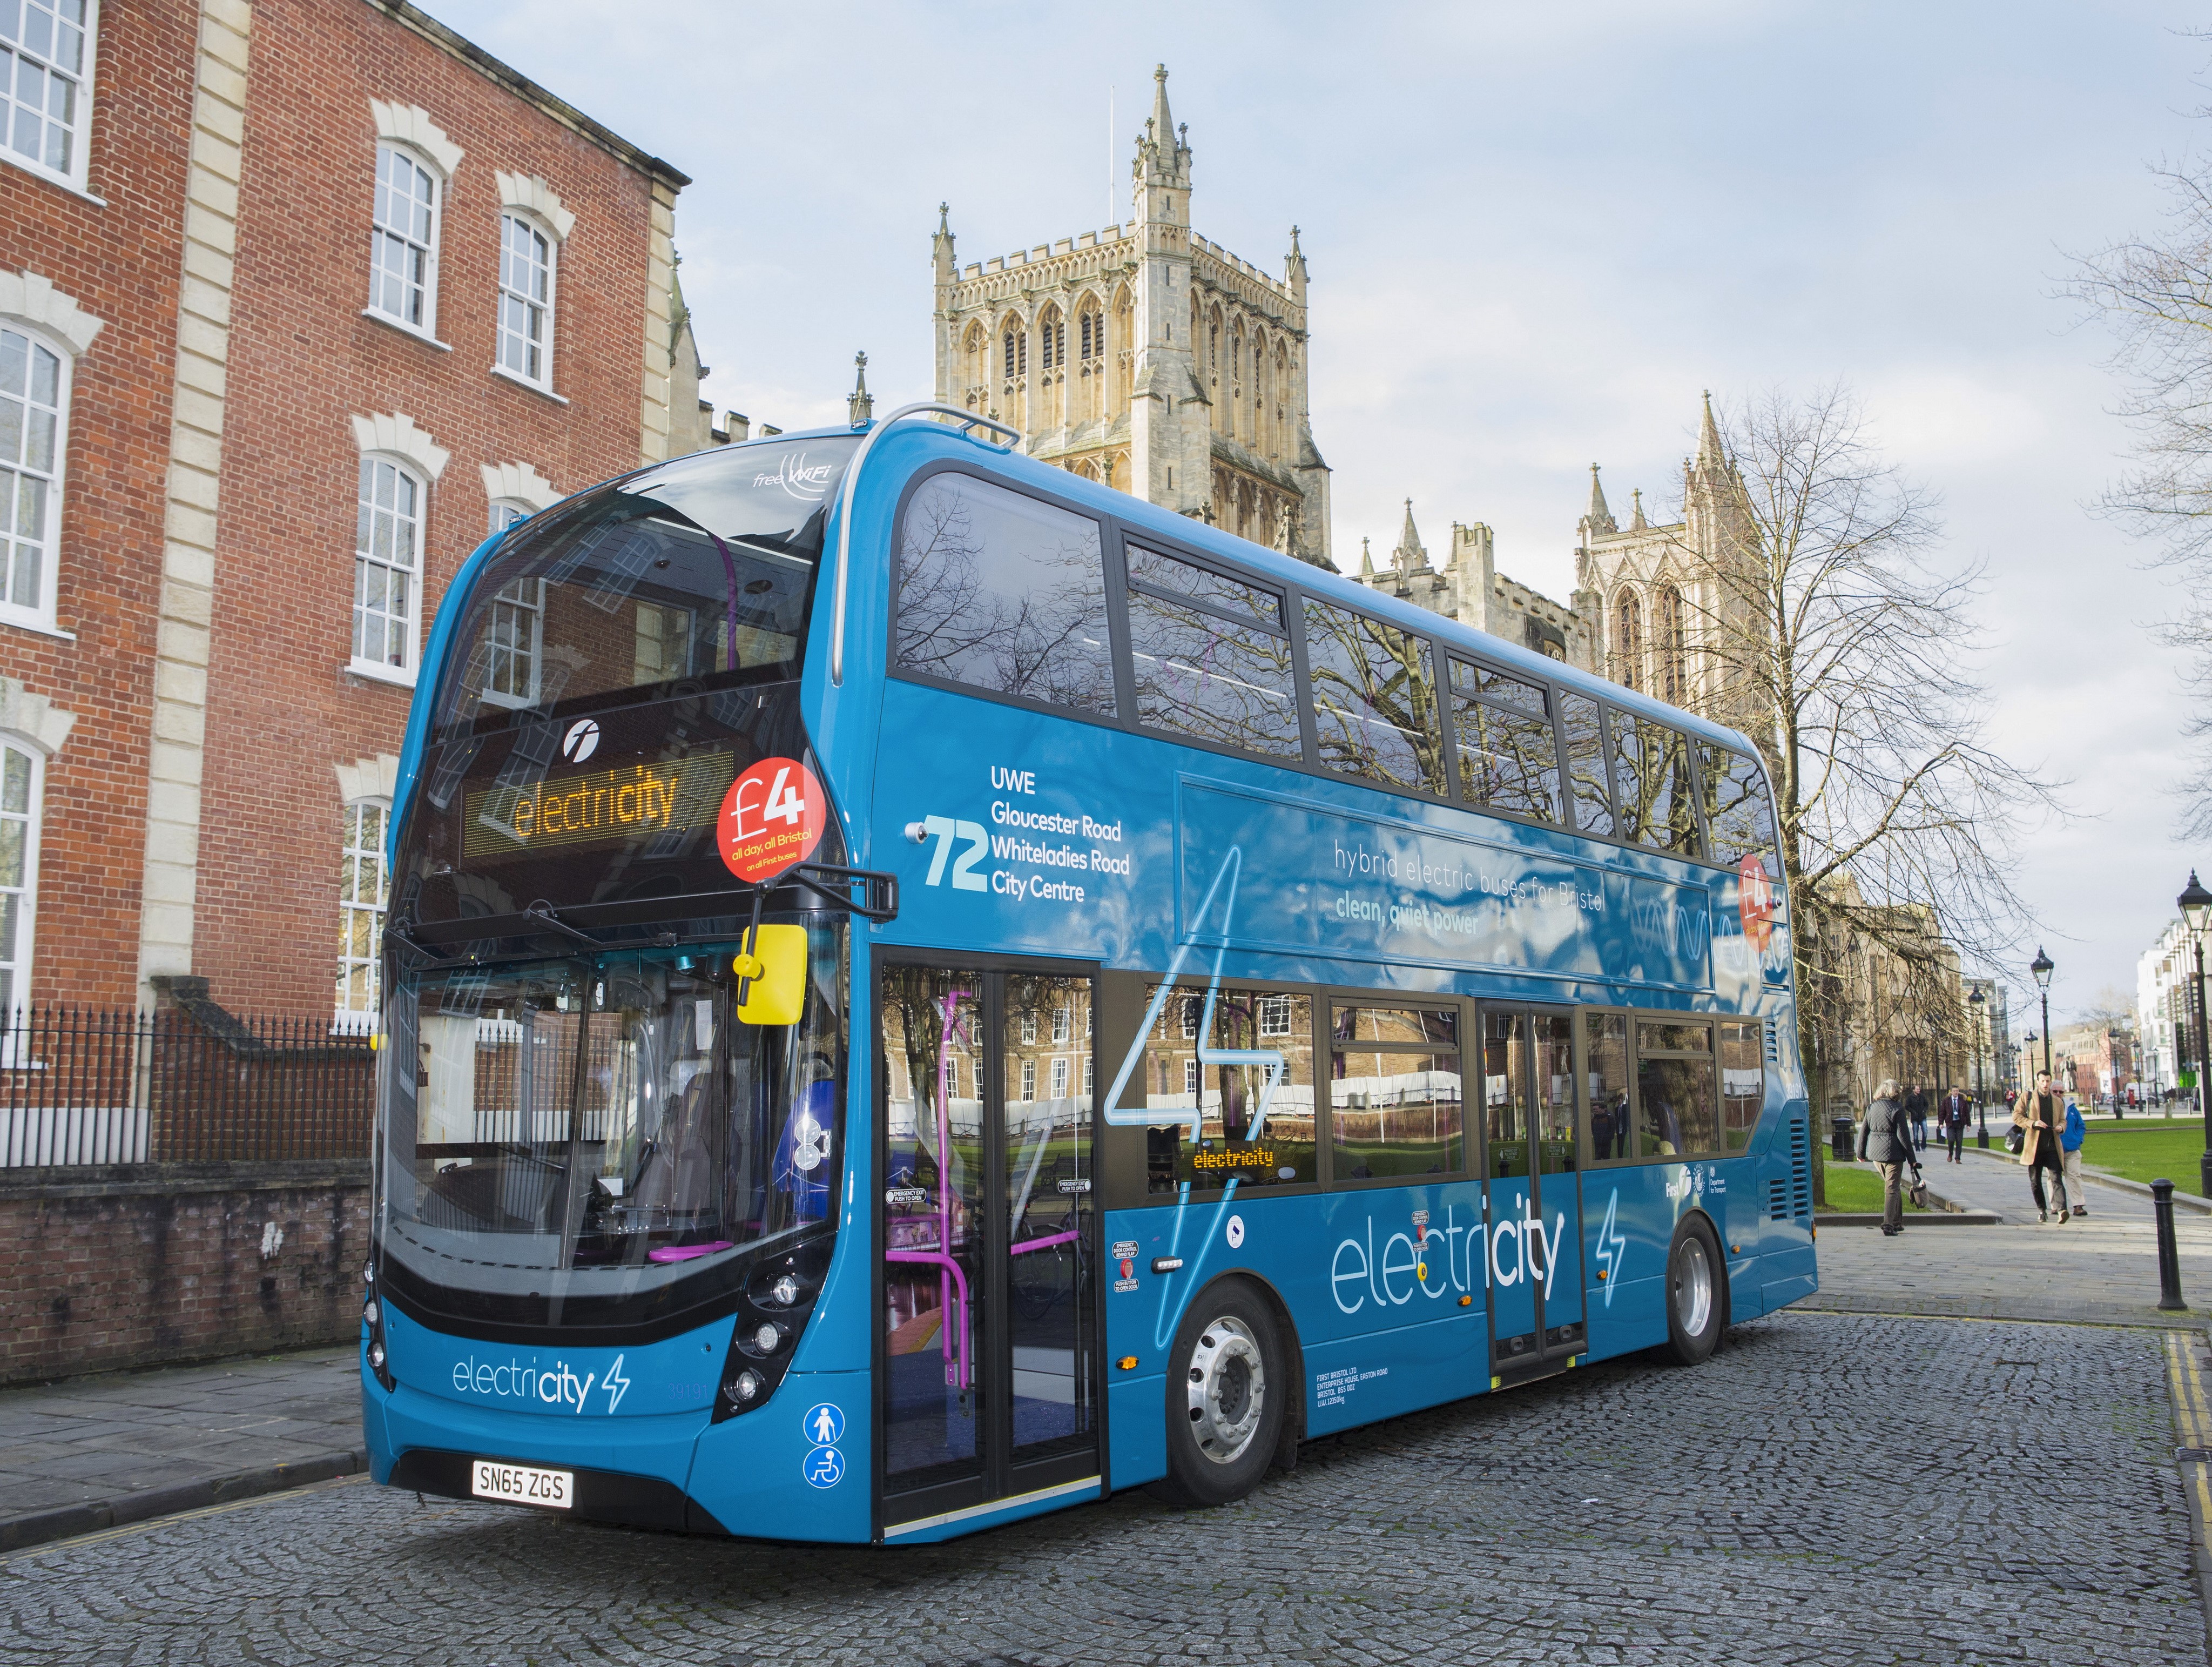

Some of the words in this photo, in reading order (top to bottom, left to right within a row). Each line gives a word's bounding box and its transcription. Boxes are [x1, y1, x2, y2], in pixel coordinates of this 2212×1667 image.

[753, 473, 784, 487] free
[991, 765, 1035, 795] UWE
[516, 765, 678, 836] electricity
[731, 767, 805, 843] £4
[991, 801, 1079, 835] Gloucester
[1082, 815, 1121, 842] Road
[732, 848, 743, 861] all
[744, 844, 763, 856] day,
[765, 837, 776, 850] all
[778, 828, 812, 846] Bristol
[763, 858, 777, 866] First
[778, 851, 797, 862] buses
[924, 815, 989, 892] 72
[991, 835, 1088, 870] Whiteladies
[1091, 850, 1130, 875] Road
[992, 870, 1027, 902] City
[1030, 875, 1084, 902] Centre
[1335, 839, 1398, 878] hybrid
[1406, 855, 1473, 891] electric
[1480, 866, 1526, 900] buses
[1531, 876, 1553, 903] for
[1559, 882, 1606, 912] Bristol
[1742, 866, 1768, 919] £4
[1336, 890, 1386, 927] clean,
[1390, 899, 1430, 931] quiet
[1433, 911, 1479, 936] power
[1194, 1147, 1273, 1168] electricity
[1666, 1182, 1679, 1197] First
[1332, 1192, 1564, 1314] electricity
[453, 1355, 595, 1414] electricity
[668, 1382, 708, 1400] 39191
[1317, 1373, 1330, 1382] FIRST
[1330, 1369, 1348, 1379] BRISTOL
[1317, 1378, 1344, 1390] ENTERPRISE
[1344, 1375, 1360, 1384] HOUSE,
[1360, 1370, 1376, 1380] EASTON
[1377, 1368, 1388, 1376] ROAD
[1317, 1389, 1336, 1399] BRISTOL
[481, 1466, 523, 1495] SN65
[529, 1473, 563, 1500] ZGS
